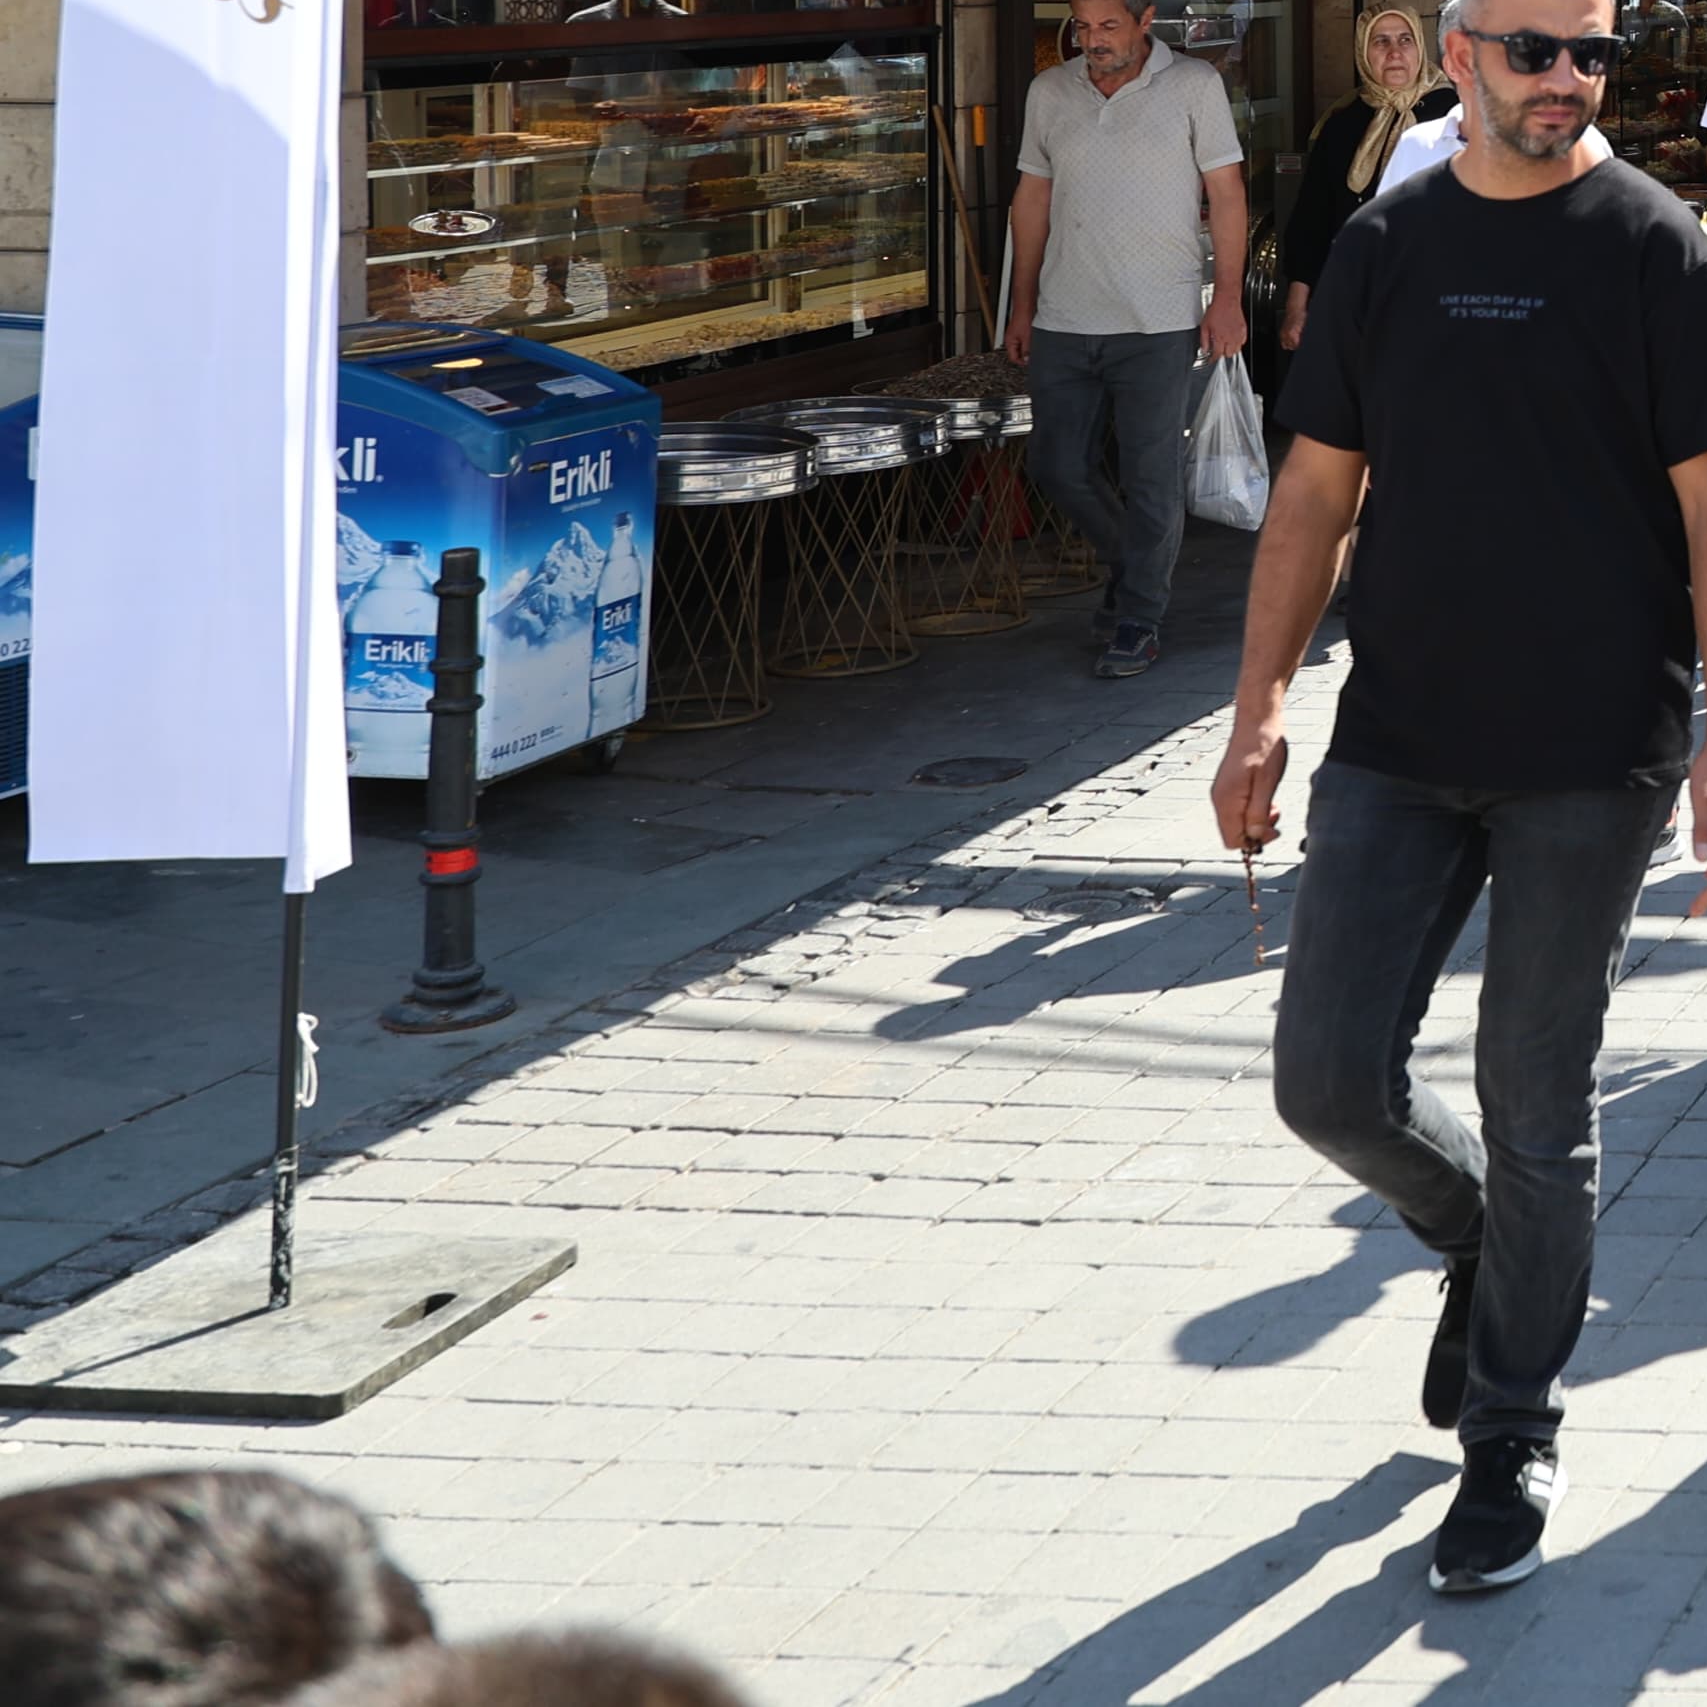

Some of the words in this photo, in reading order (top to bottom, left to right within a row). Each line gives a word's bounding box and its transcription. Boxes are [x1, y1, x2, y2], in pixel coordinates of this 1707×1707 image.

[1462, 295, 1491, 305] EACH
[336, 438, 378, 482] kli
[550, 450, 612, 505] Erikli
[602, 602, 632, 631] Erikli
[364, 638, 427, 664] Erikli
[490, 739, 512, 761] 444
[512, 737, 518, 754] 0
[520, 733, 537, 752] 222
